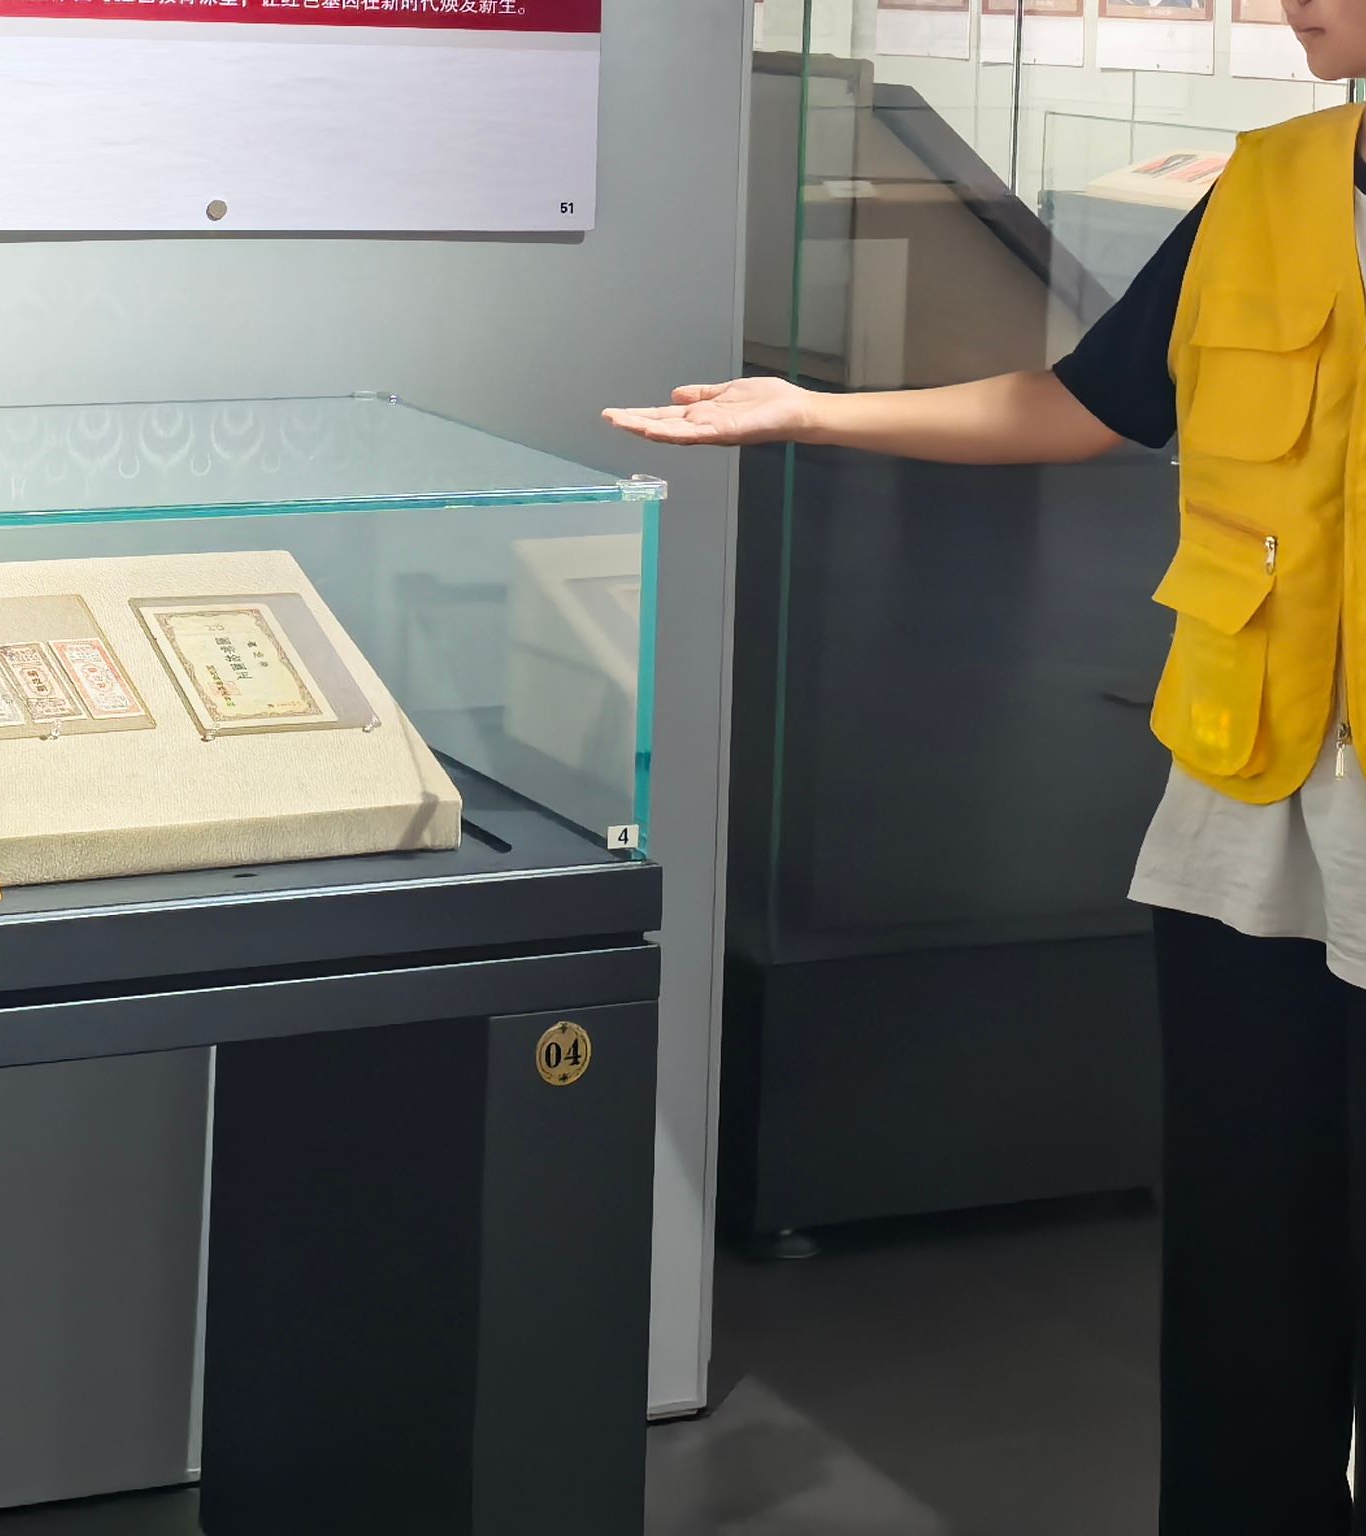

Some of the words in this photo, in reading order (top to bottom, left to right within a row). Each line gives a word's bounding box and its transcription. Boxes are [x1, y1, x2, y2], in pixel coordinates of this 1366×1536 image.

[560, 202, 574, 214] 51
[618, 827, 629, 845] 4
[544, 1038, 582, 1069] 04
